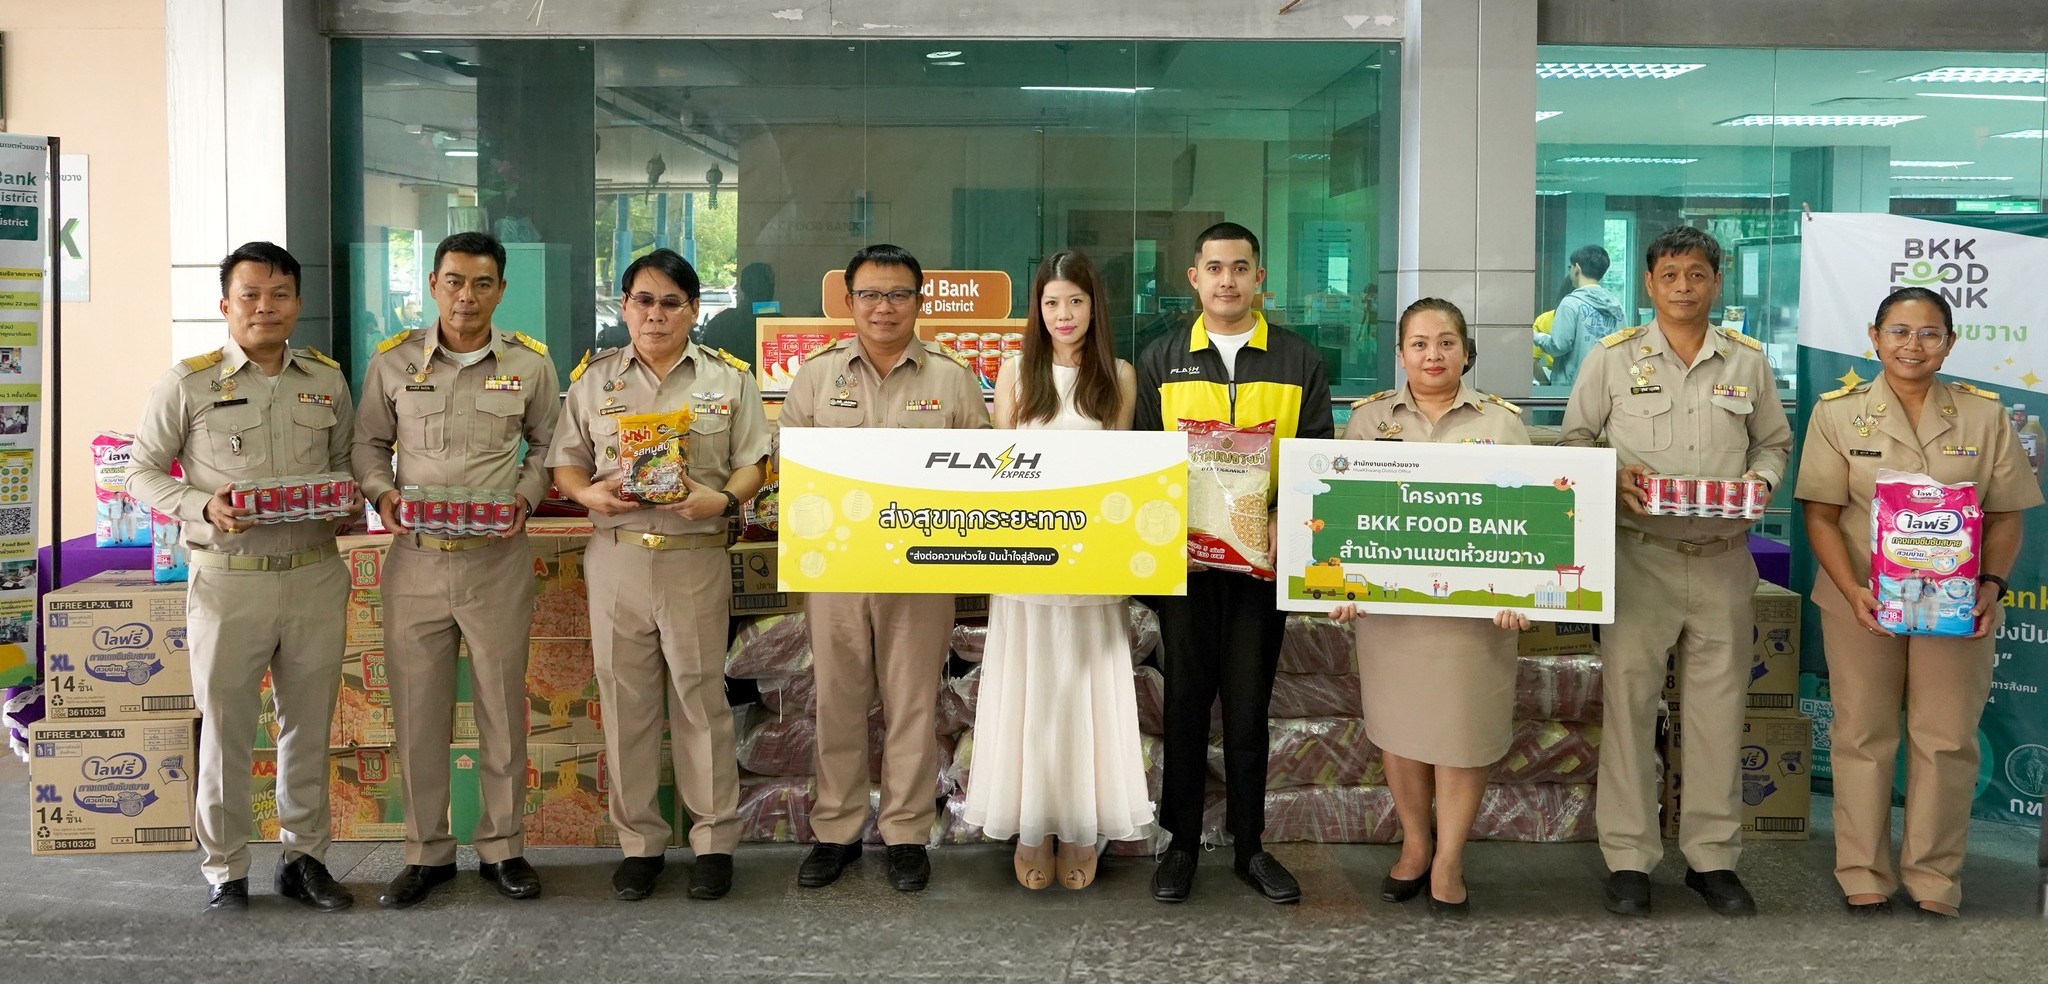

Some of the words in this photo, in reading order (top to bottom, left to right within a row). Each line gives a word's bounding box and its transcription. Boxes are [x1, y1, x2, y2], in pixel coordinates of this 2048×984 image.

[0, 142, 47, 151] นเขตห้วยขวาง
[1, 191, 38, 203] istrict
[0, 218, 29, 227] istrict
[1904, 238, 1976, 260] BKK
[1890, 261, 1989, 284] FOOD
[938, 279, 979, 297] Bank
[935, 300, 974, 313] District
[634, 442, 670, 456] รสหมูสับ
[1353, 460, 1419, 468] สำนักงานเขตห้วยขวาง
[1000, 470, 1041, 479] EXPRESS
[1400, 484, 1482, 505] โครงการ
[878, 502, 1087, 537] ส่งสุขทุกระยะทาง
[1357, 515, 1400, 531] BKK
[1406, 516, 1463, 533] FOOD
[1469, 518, 1528, 535] BANK
[1904, 514, 1951, 530] ไลฟ์รี่
[1340, 540, 1545, 564] สำนักงานเขตห้วยขวาง
[356, 561, 375, 576] 10
[51, 601, 112, 610] LIFREE-LP-XL
[115, 600, 132, 609] 14K
[1558, 624, 1587, 633] TALAY
[101, 629, 144, 645] ไลฟ์รี่
[50, 654, 75, 672] XL
[51, 676, 75, 692] 14
[78, 679, 93, 692] ชิ้น
[1991, 682, 2037, 693] การสังคม
[68, 708, 104, 717] 3610326
[37, 730, 102, 739] LIFREE-LP-XL
[106, 729, 124, 738] 14K
[91, 759, 136, 775] ไลฟ์รี่
[363, 758, 382, 772] 10
[36, 785, 62, 803] XL
[37, 807, 63, 824] 14
[66, 810, 82, 824] ชิ้น
[56, 840, 95, 849] 3610326
